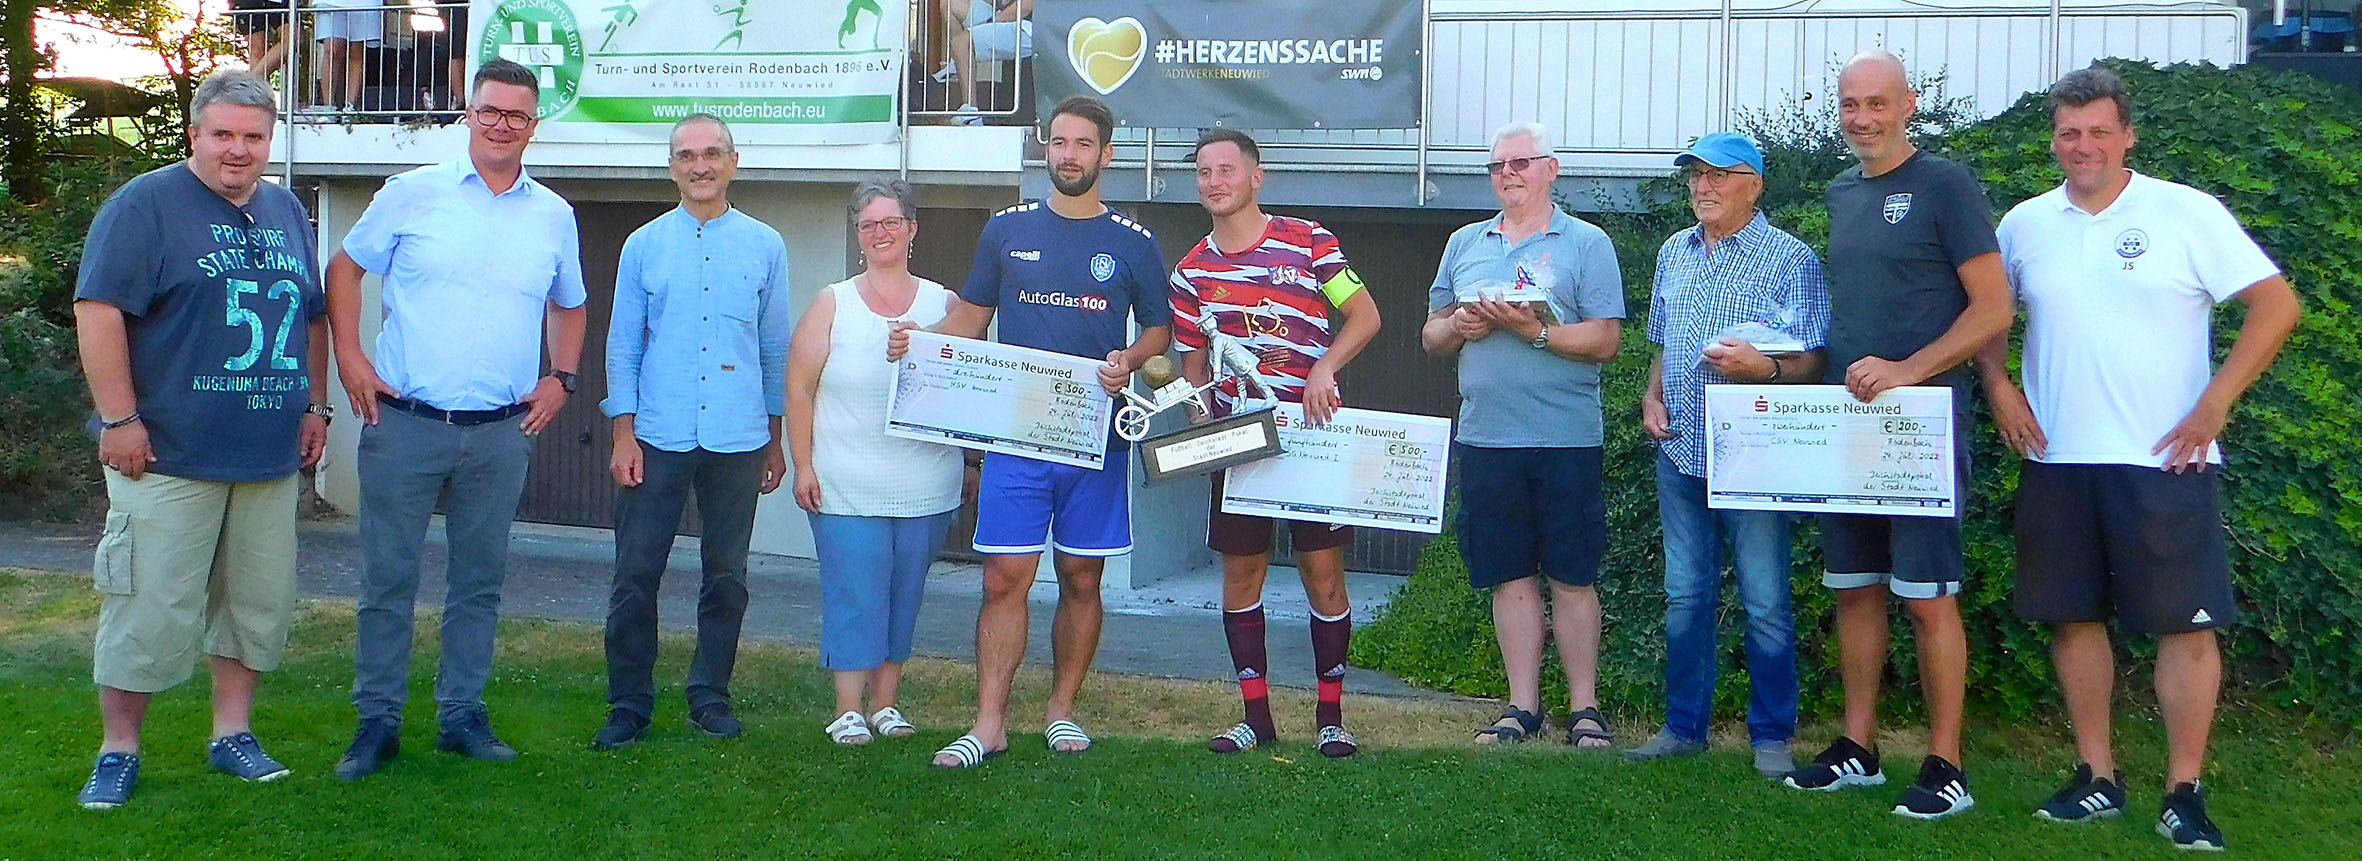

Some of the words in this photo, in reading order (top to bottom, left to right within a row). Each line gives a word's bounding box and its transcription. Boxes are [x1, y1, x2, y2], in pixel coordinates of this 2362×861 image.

[514, 46, 551, 63] TUS
[1155, 39, 1383, 64] #HERZENSSACHE
[595, 63, 628, 75] Turn-
[633, 63, 657, 74] und
[662, 61, 743, 76] Sportverein
[749, 62, 828, 74] Rodenbach
[866, 59, 893, 71] e.V.
[1340, 69, 1369, 79] swn
[652, 101, 826, 118] wwwtusrodenbach.eu
[211, 224, 247, 245] PRO
[250, 228, 286, 247] SURF
[197, 248, 250, 277] STATE
[2122, 261, 2134, 271] JS
[1018, 289, 1079, 307] AutoGlas
[1082, 296, 1107, 311] 100
[224, 277, 299, 372] 52
[957, 351, 1018, 370] Sparkasse
[1021, 361, 1073, 379] Neuwied
[262, 376, 294, 391] BEACH
[247, 395, 283, 410] TOKYO
[1773, 401, 1840, 415] Sparkasse
[1844, 403, 1901, 415] Neuwied
[1355, 424, 1406, 440] Neuwied
